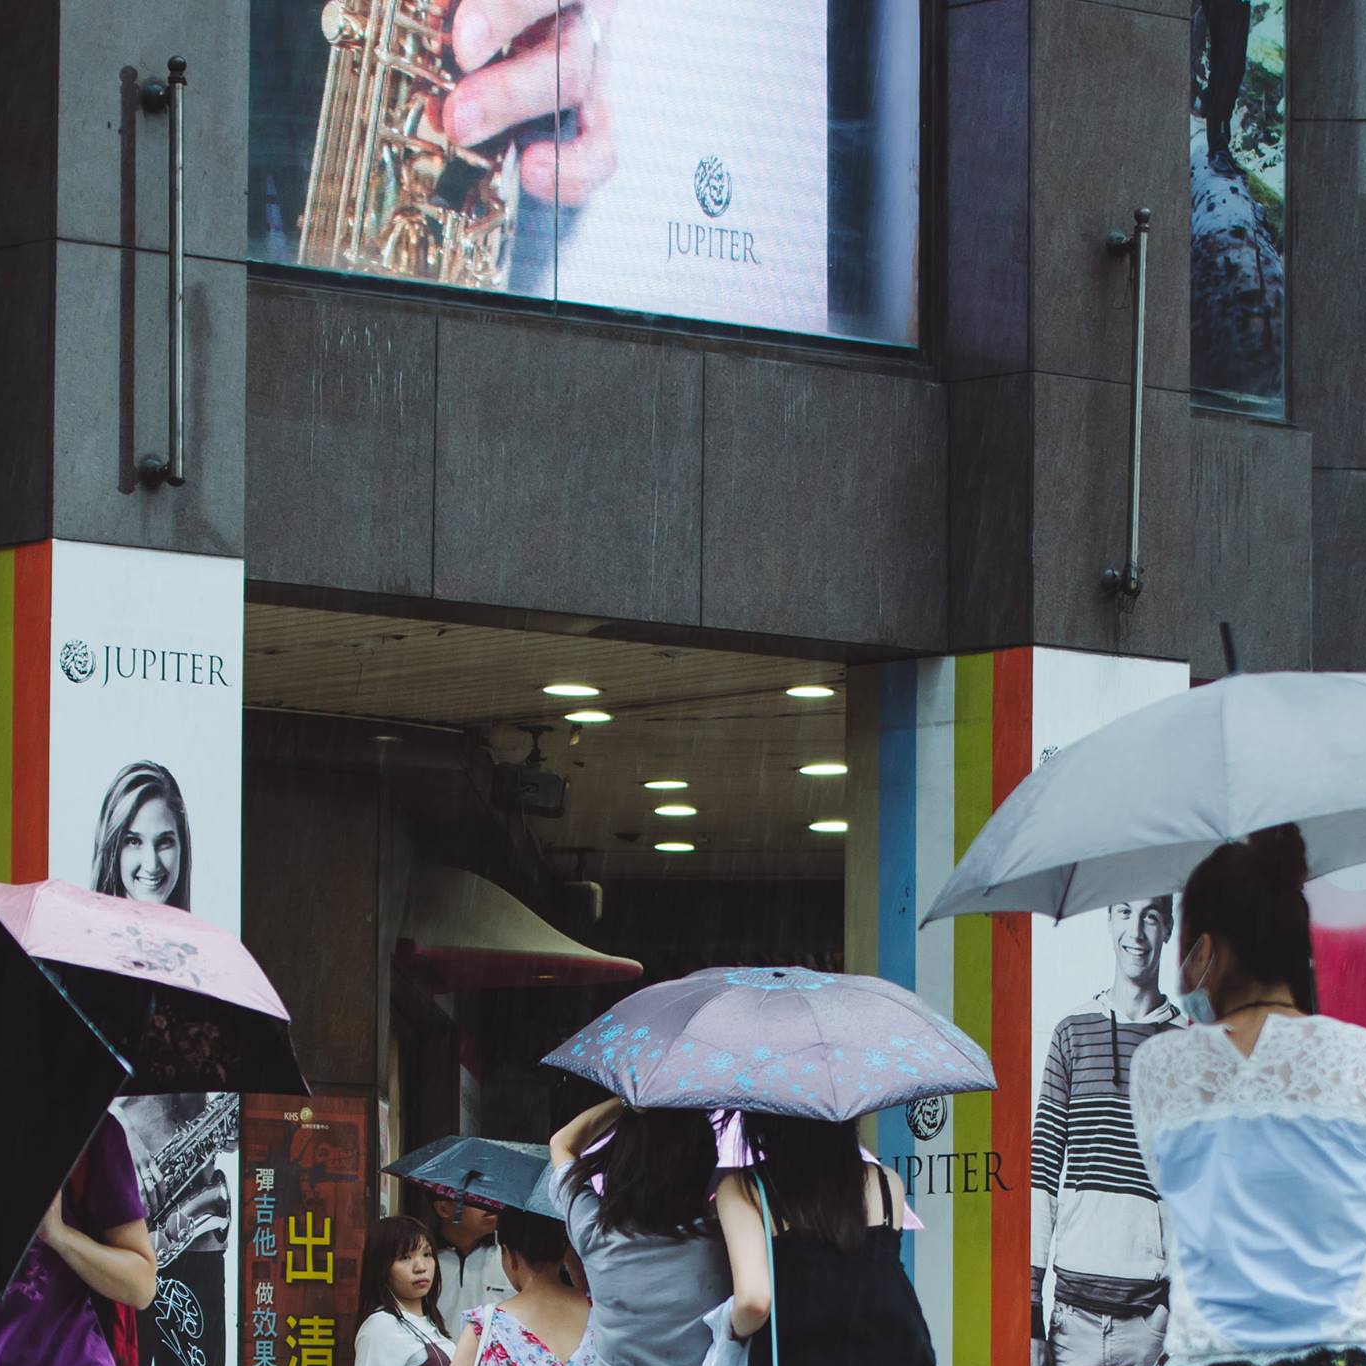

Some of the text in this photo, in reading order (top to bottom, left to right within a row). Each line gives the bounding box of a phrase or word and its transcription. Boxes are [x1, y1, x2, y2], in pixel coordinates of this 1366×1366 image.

[667, 220, 761, 264] JUPITER
[101, 644, 233, 688] JUPITER
[284, 1112, 299, 1122] KHS
[253, 1168, 277, 1258] 彈吉他
